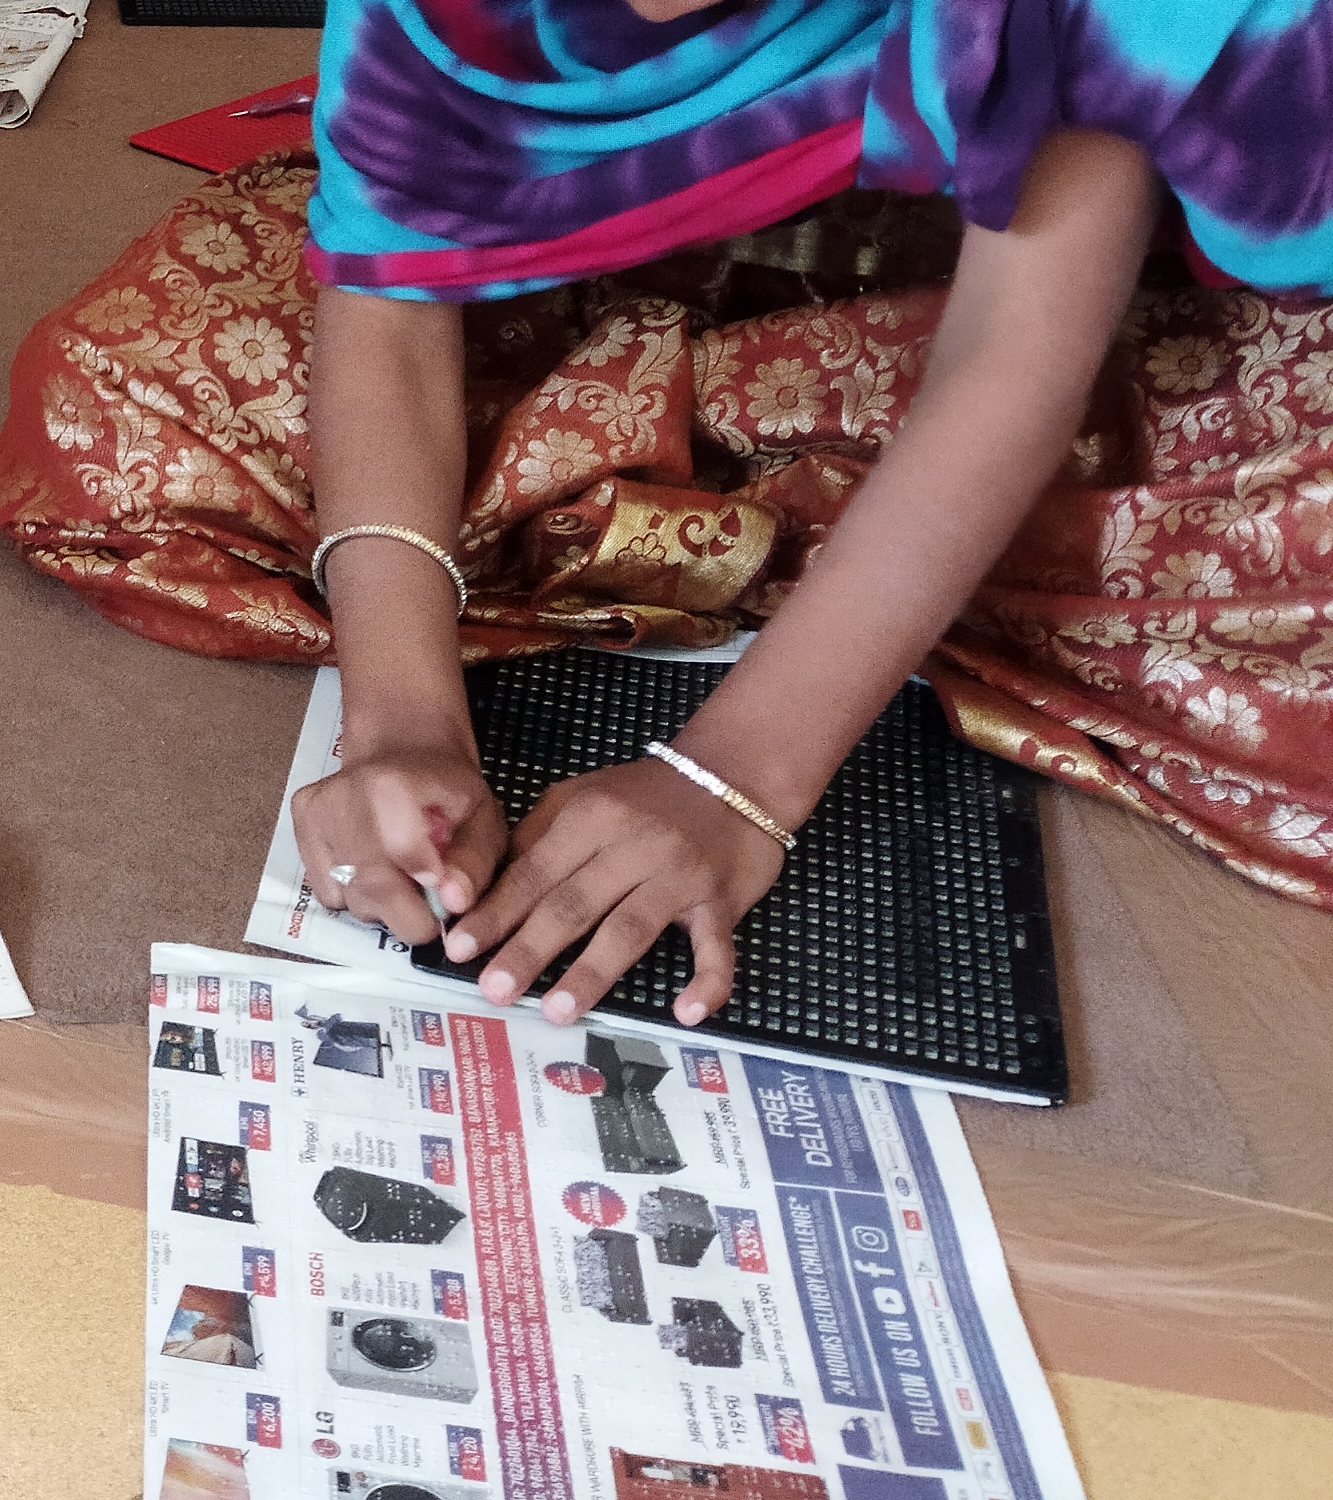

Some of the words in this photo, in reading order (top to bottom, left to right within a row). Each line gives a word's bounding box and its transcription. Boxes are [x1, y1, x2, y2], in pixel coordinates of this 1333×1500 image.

[291, 1038, 305, 1084] HENRY
[759, 1088, 793, 1138] FREE
[781, 1071, 833, 1168] DELIVERY
[303, 1120, 319, 1163] Whirlpool
[739, 1217, 757, 1264] 33%
[308, 1252, 325, 1297] BOSCH
[804, 1273, 840, 1337] DELIVERY
[881, 1317, 912, 1343] ON
[818, 1330, 851, 1381] HOURS
[893, 1345, 919, 1366] US
[830, 1376, 857, 1401] 24
[899, 1366, 941, 1437] FOLLOW
[315, 1411, 334, 1435] LG
[715, 1416, 729, 1452] Special
